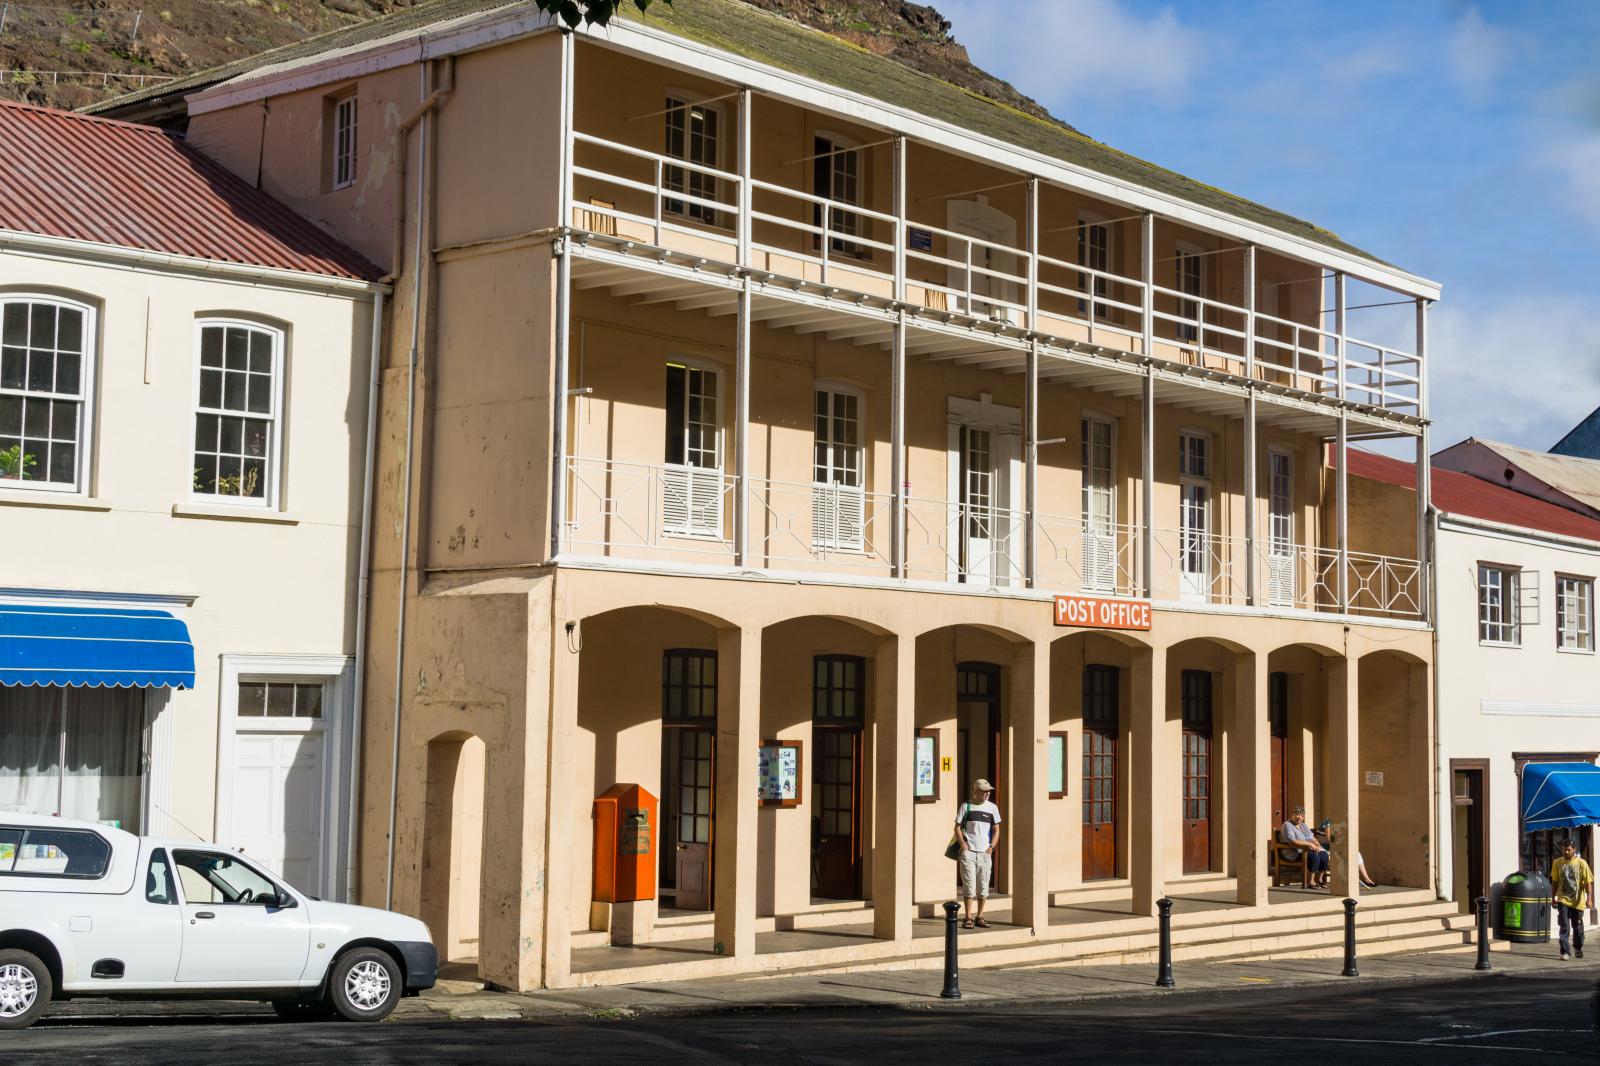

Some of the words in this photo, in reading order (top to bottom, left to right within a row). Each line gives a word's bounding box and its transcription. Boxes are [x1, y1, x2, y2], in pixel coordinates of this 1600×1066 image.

[1058, 598, 1096, 623] POST
[1101, 602, 1150, 627] OFFICE
[943, 758, 950, 771] H
